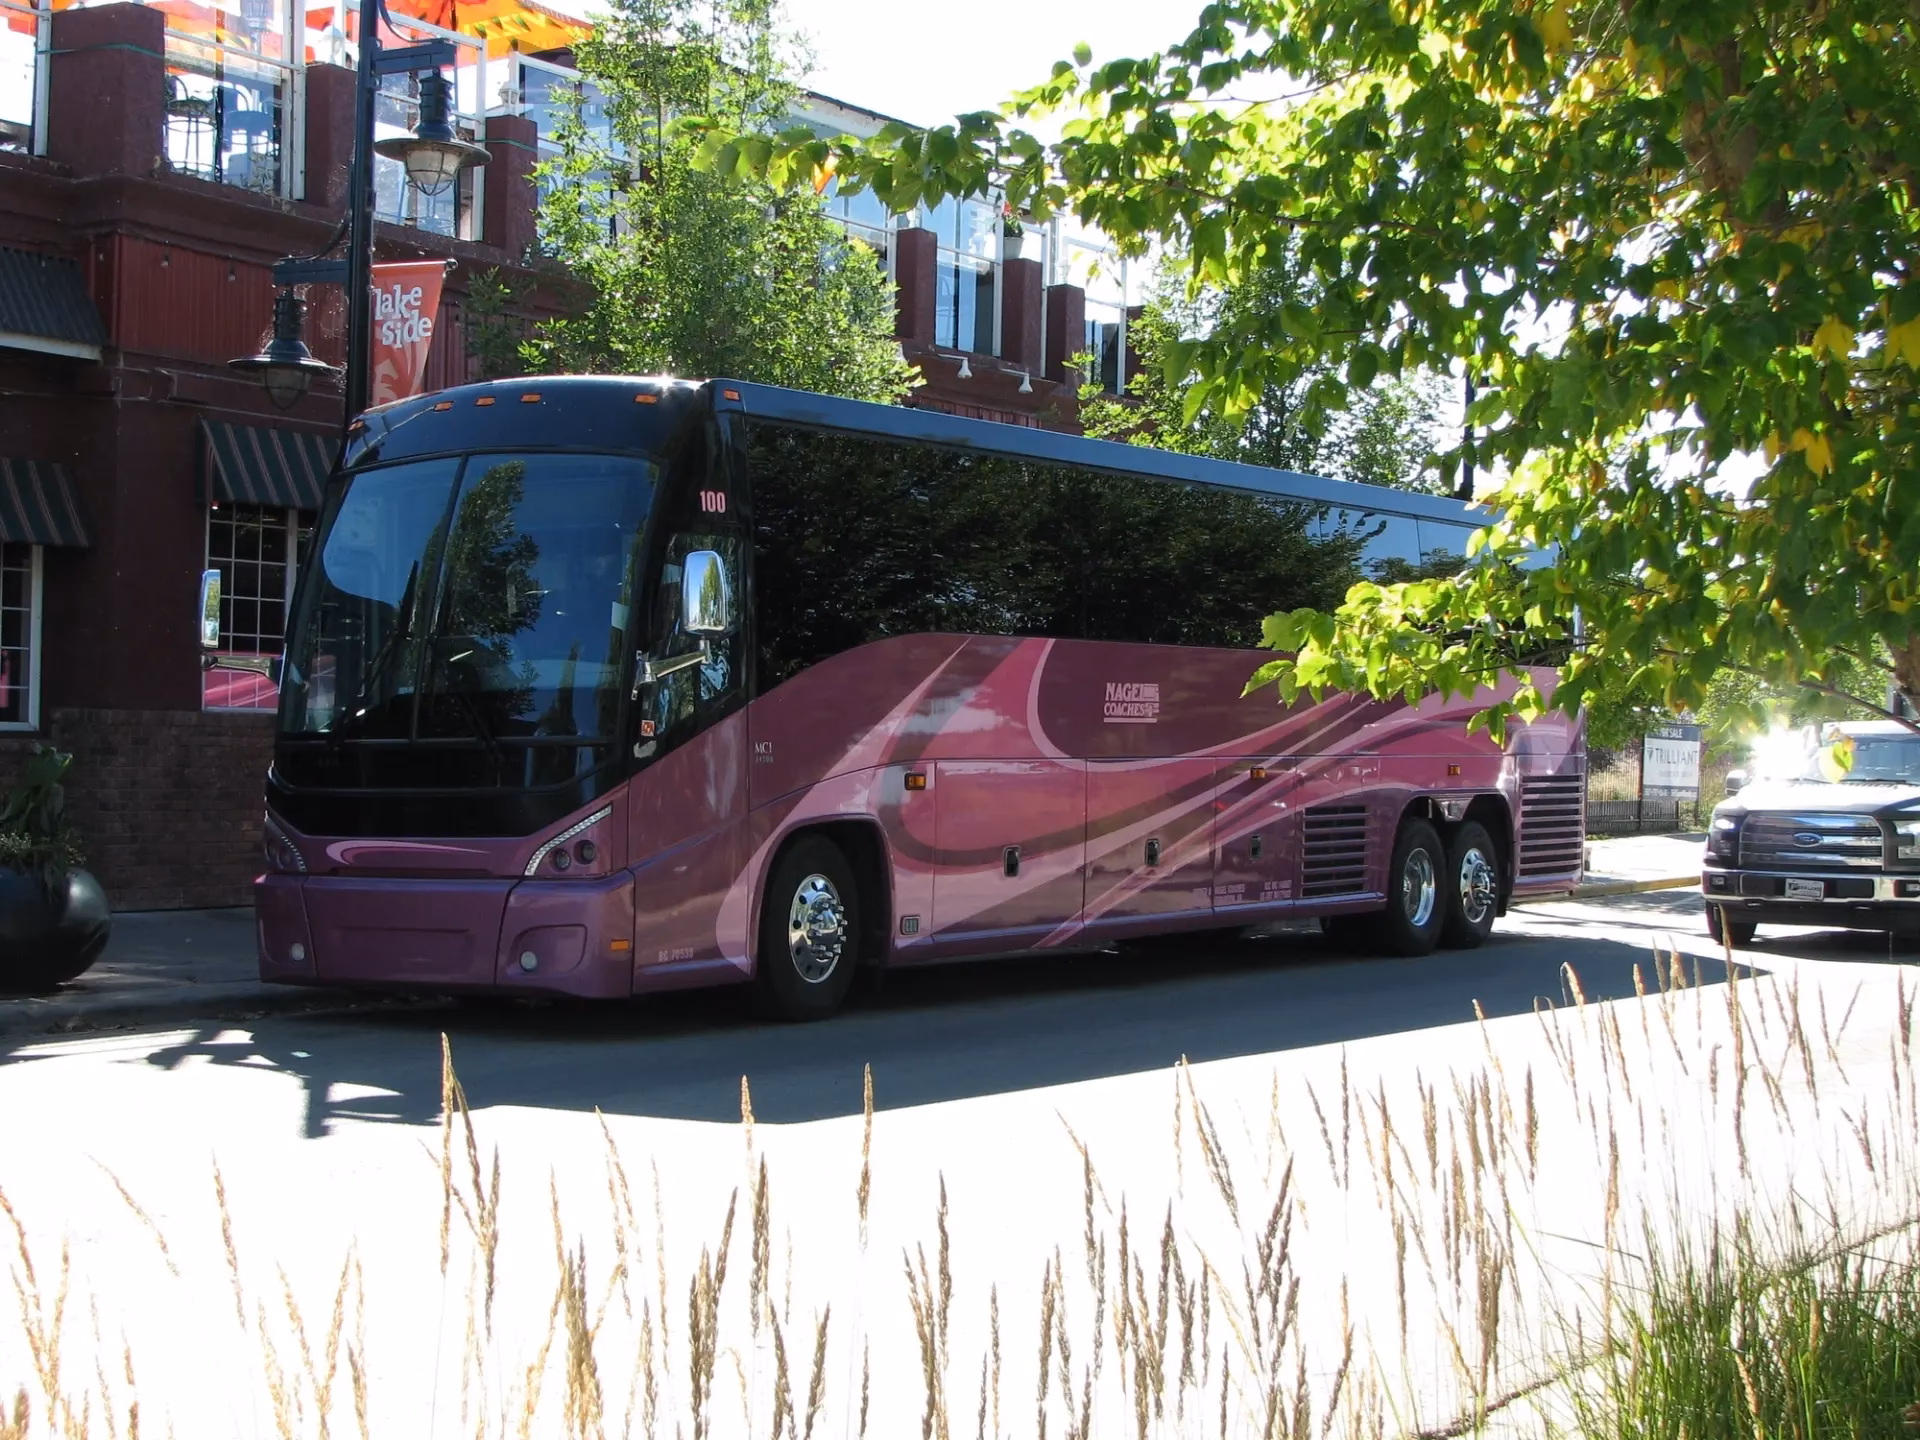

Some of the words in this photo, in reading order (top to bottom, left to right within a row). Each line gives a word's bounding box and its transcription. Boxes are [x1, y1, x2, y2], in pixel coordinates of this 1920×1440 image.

[372, 284, 423, 321] lake
[382, 309, 432, 349] side
[699, 490, 727, 514] 100
[1103, 702, 1145, 717] COACHES
[1669, 727, 1683, 739] SALE
[755, 741, 772, 754] MCI
[1655, 747, 1698, 765] TRILLIANT
